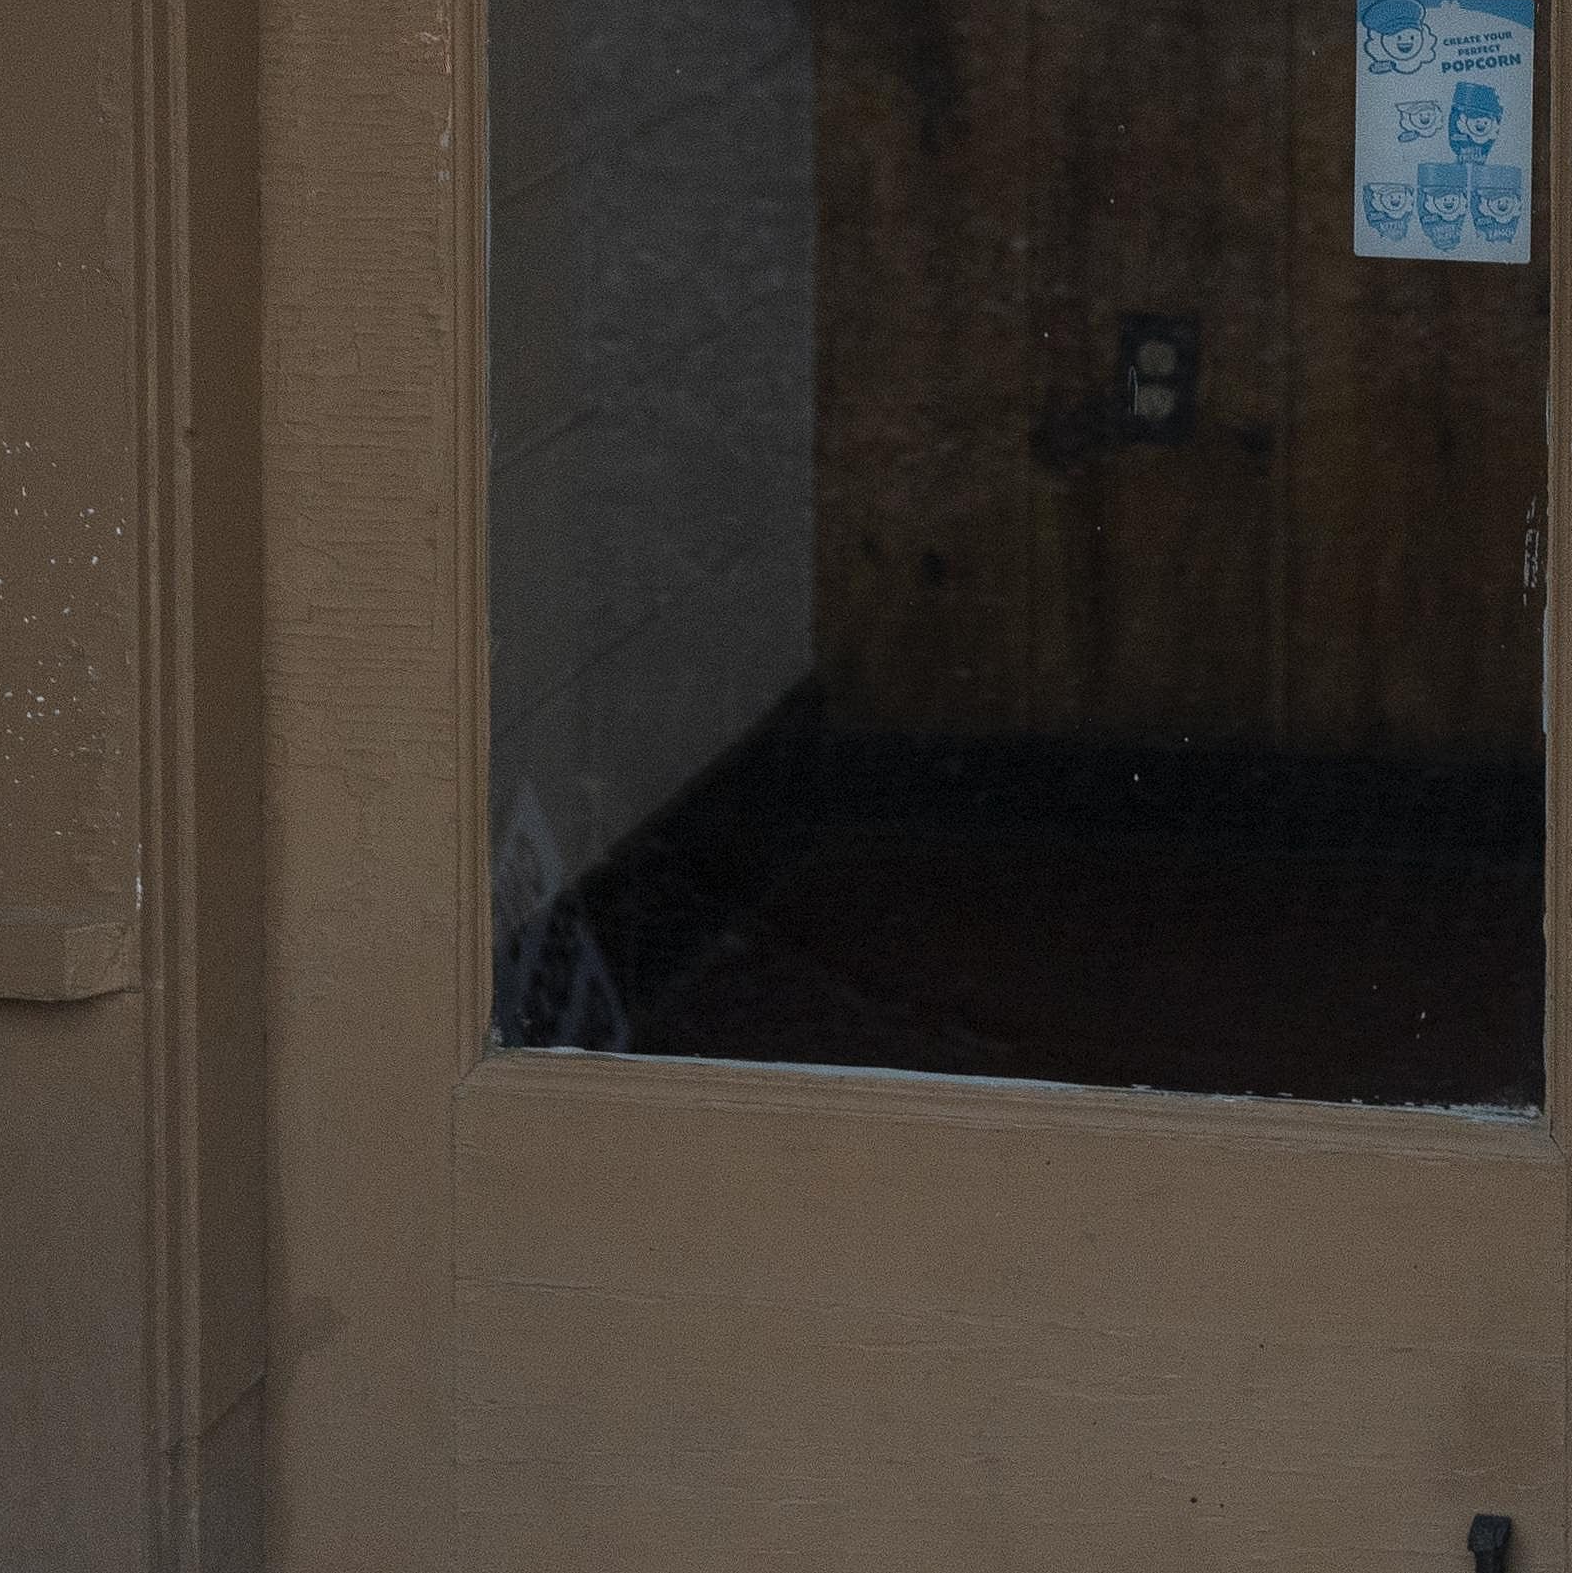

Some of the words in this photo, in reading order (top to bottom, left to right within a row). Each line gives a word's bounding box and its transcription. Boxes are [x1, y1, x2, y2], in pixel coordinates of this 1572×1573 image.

[1443, 35, 1482, 46] CREATE
[1483, 31, 1513, 42] YOUR
[1458, 44, 1501, 56] PERFECT
[1441, 53, 1522, 74] POPCORN
